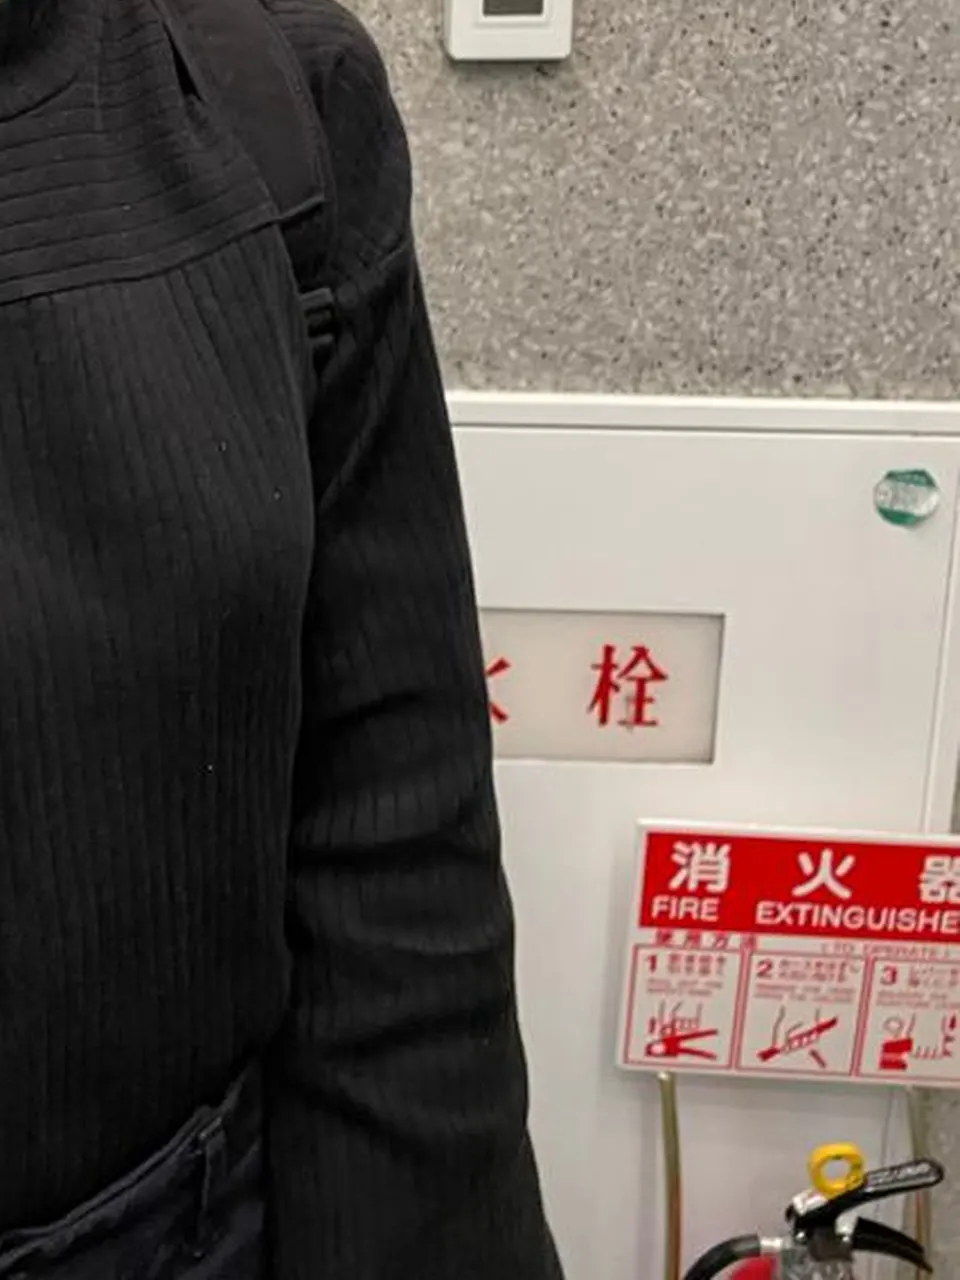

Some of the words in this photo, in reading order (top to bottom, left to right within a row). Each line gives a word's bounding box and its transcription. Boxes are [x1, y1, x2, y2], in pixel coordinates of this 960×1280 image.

[651, 895, 721, 922] FIRE
[755, 900, 960, 934] EXTINGUISHE
[646, 954, 658, 973] 1
[755, 959, 774, 979] 2
[880, 966, 898, 987] 3
